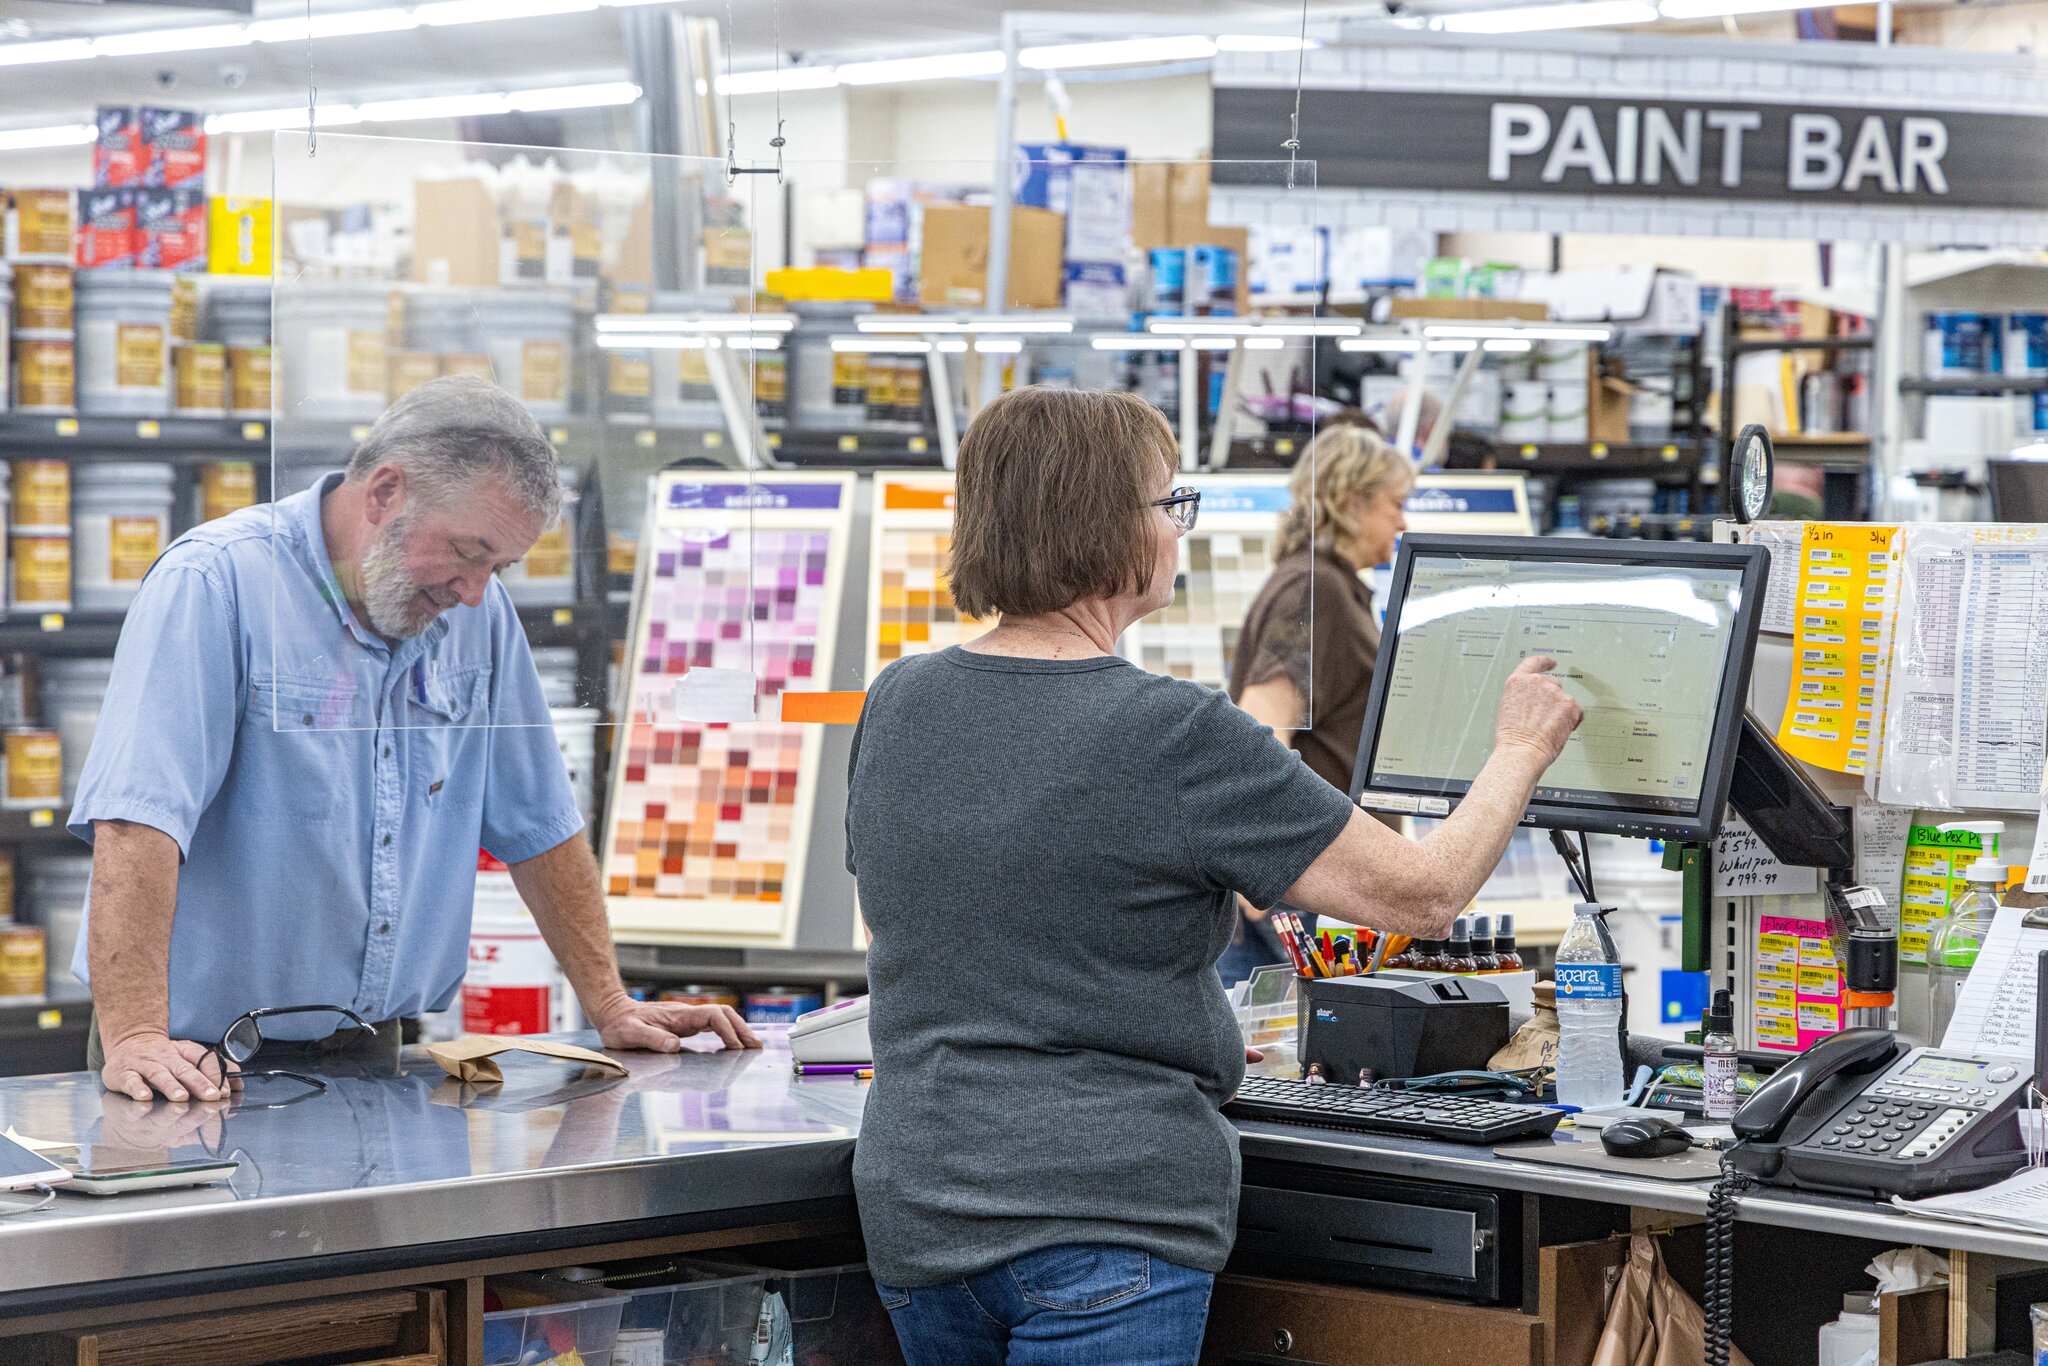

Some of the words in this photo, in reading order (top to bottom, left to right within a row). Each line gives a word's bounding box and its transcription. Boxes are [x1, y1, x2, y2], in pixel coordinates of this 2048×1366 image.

[1488, 102, 1763, 187] PAINT
[1787, 112, 1950, 195] BAR
[1870, 531, 1886, 544] 3/4
[1917, 828, 1940, 842] Blue
[1946, 832, 1962, 843] Pex
[1765, 916, 1790, 931] Floor
[1555, 967, 1600, 983] iagara
